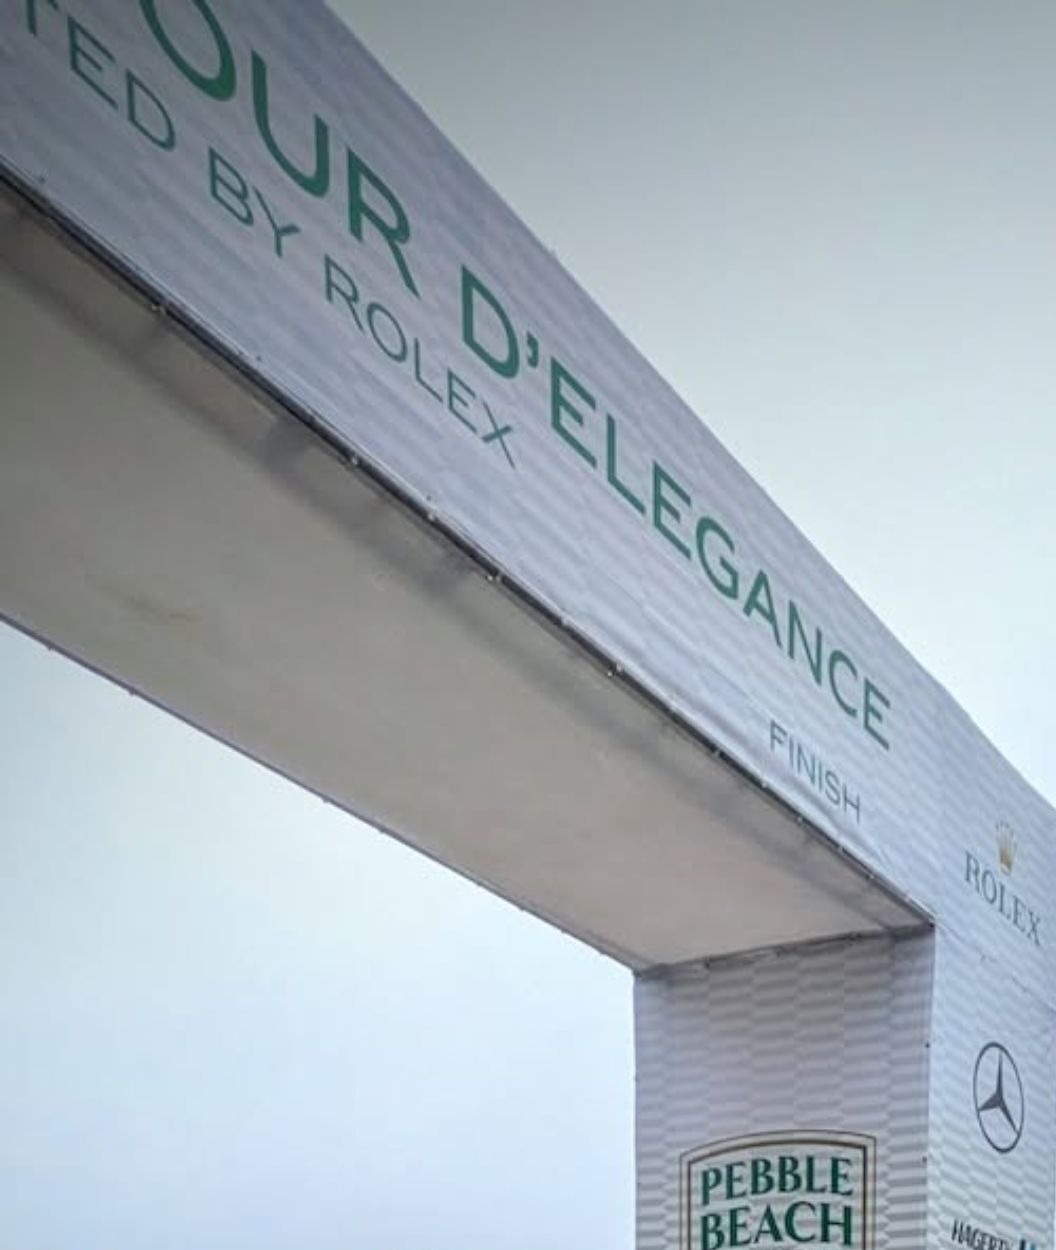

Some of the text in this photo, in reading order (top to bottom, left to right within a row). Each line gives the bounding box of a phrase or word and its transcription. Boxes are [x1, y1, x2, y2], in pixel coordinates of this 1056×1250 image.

[208, 147, 300, 258] BY
[325, 254, 517, 469] ROLEX
[460, 264, 892, 752] D'ELEGANCE
[769, 719, 861, 824] FINISH
[964, 849, 1041, 947] ROLEX
[701, 1155, 854, 1206] PEBBLE
